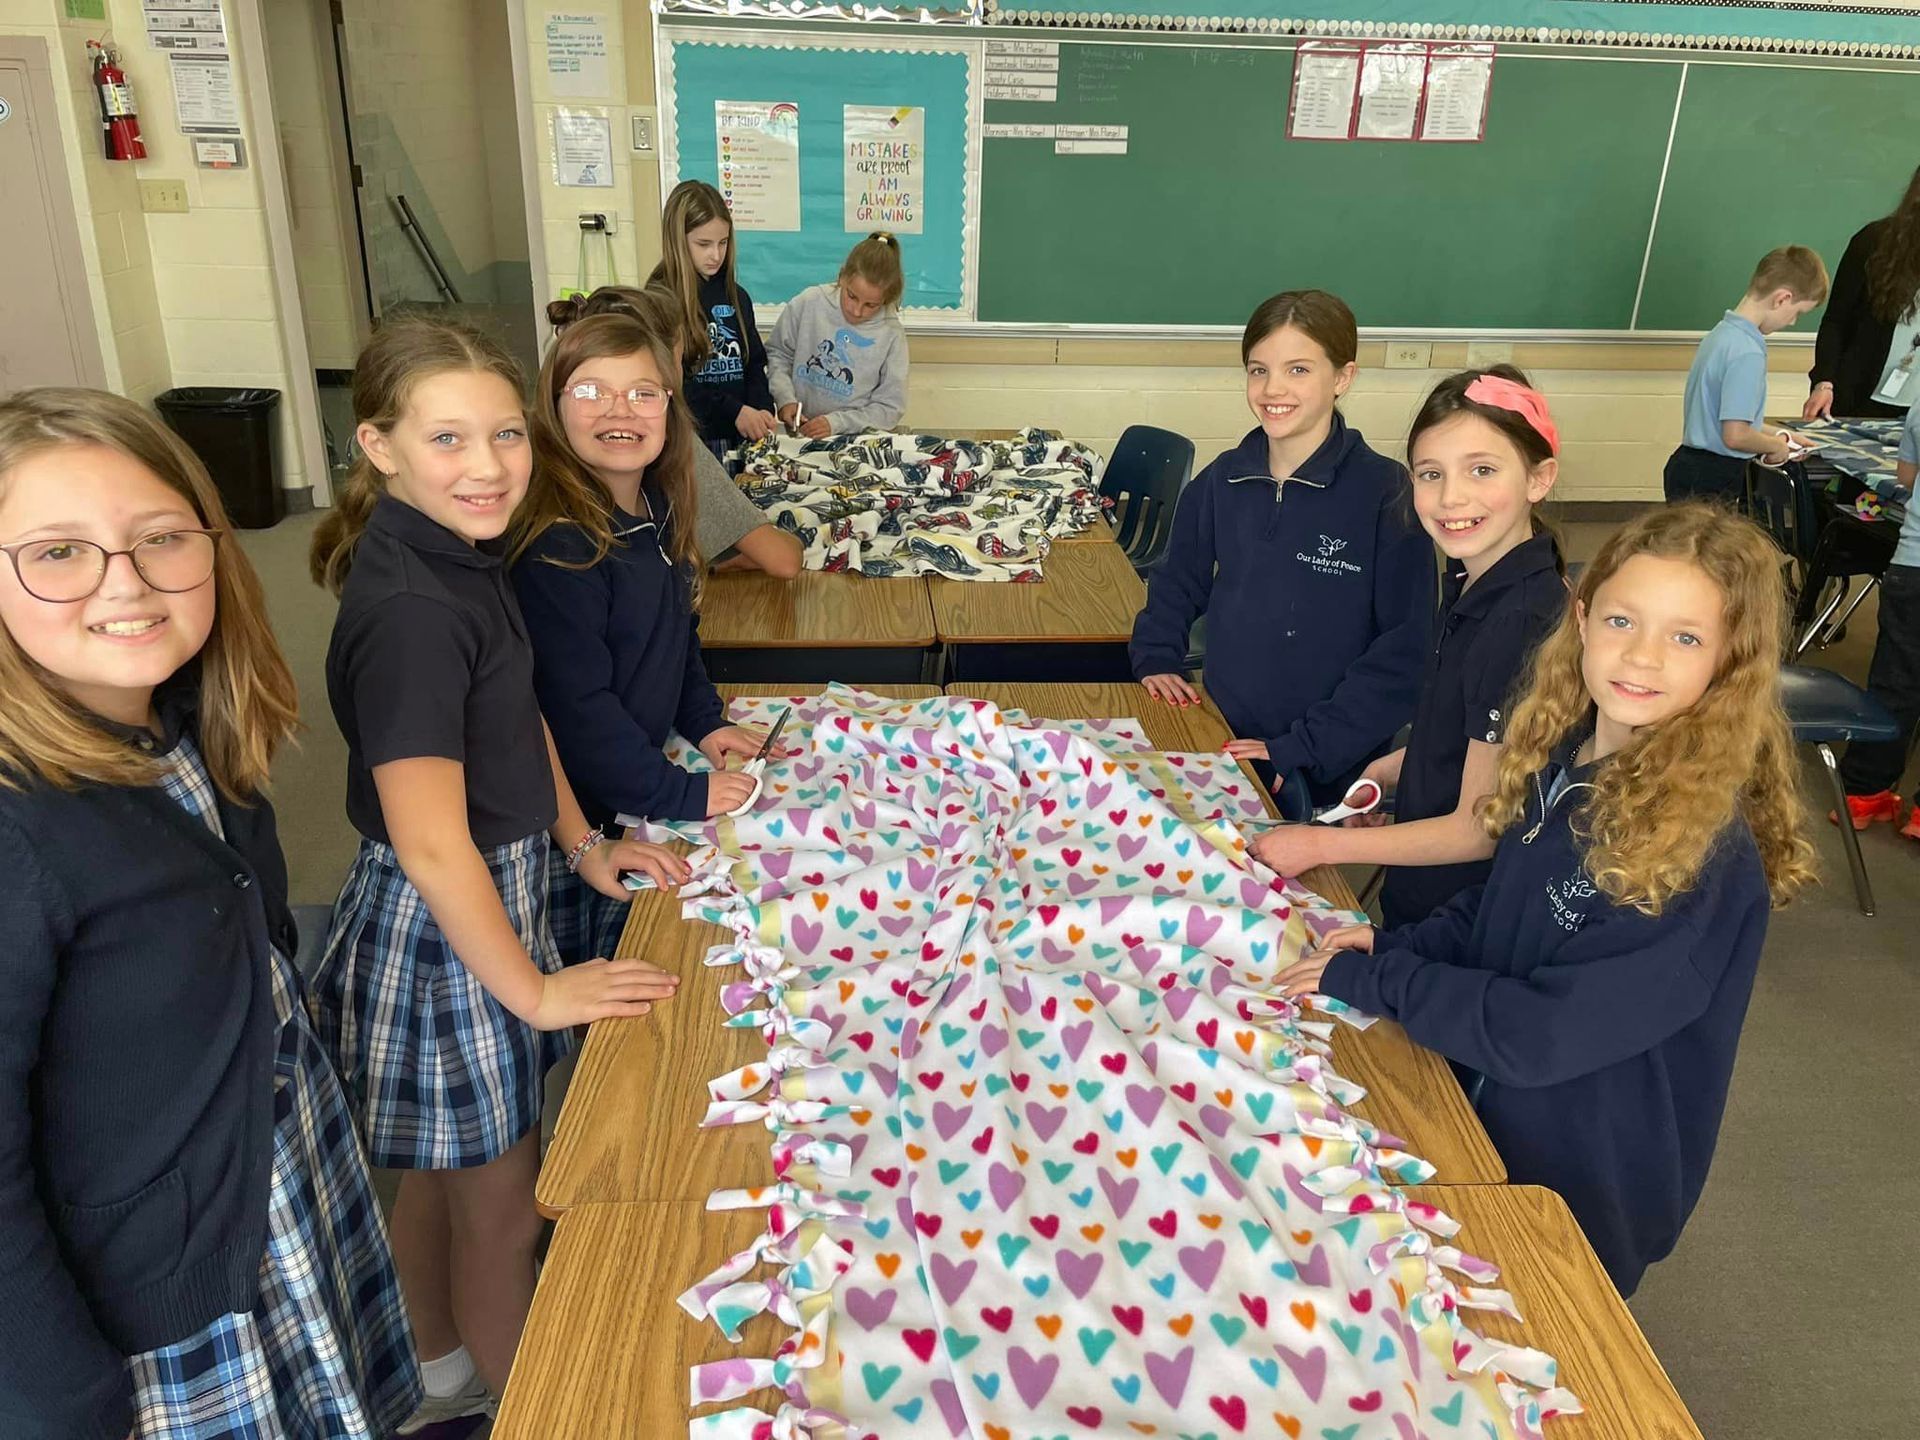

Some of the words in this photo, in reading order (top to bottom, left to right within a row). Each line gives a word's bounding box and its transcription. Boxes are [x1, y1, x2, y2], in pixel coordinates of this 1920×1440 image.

[721, 115, 732, 127] BE
[737, 115, 761, 128] KIND
[850, 142, 918, 158] MISTAKES
[879, 178, 898, 190] AM
[860, 192, 910, 206] ALWAYS
[857, 207, 913, 222] GROWING
[720, 374, 728, 382] of
[1296, 552, 1311, 562] Our
[1312, 556, 1331, 567] Lady
[1331, 560, 1340, 568] of
[1341, 561, 1361, 572] Peace
[1312, 565, 1342, 575] SCHOOL
[1565, 910, 1579, 923] of
